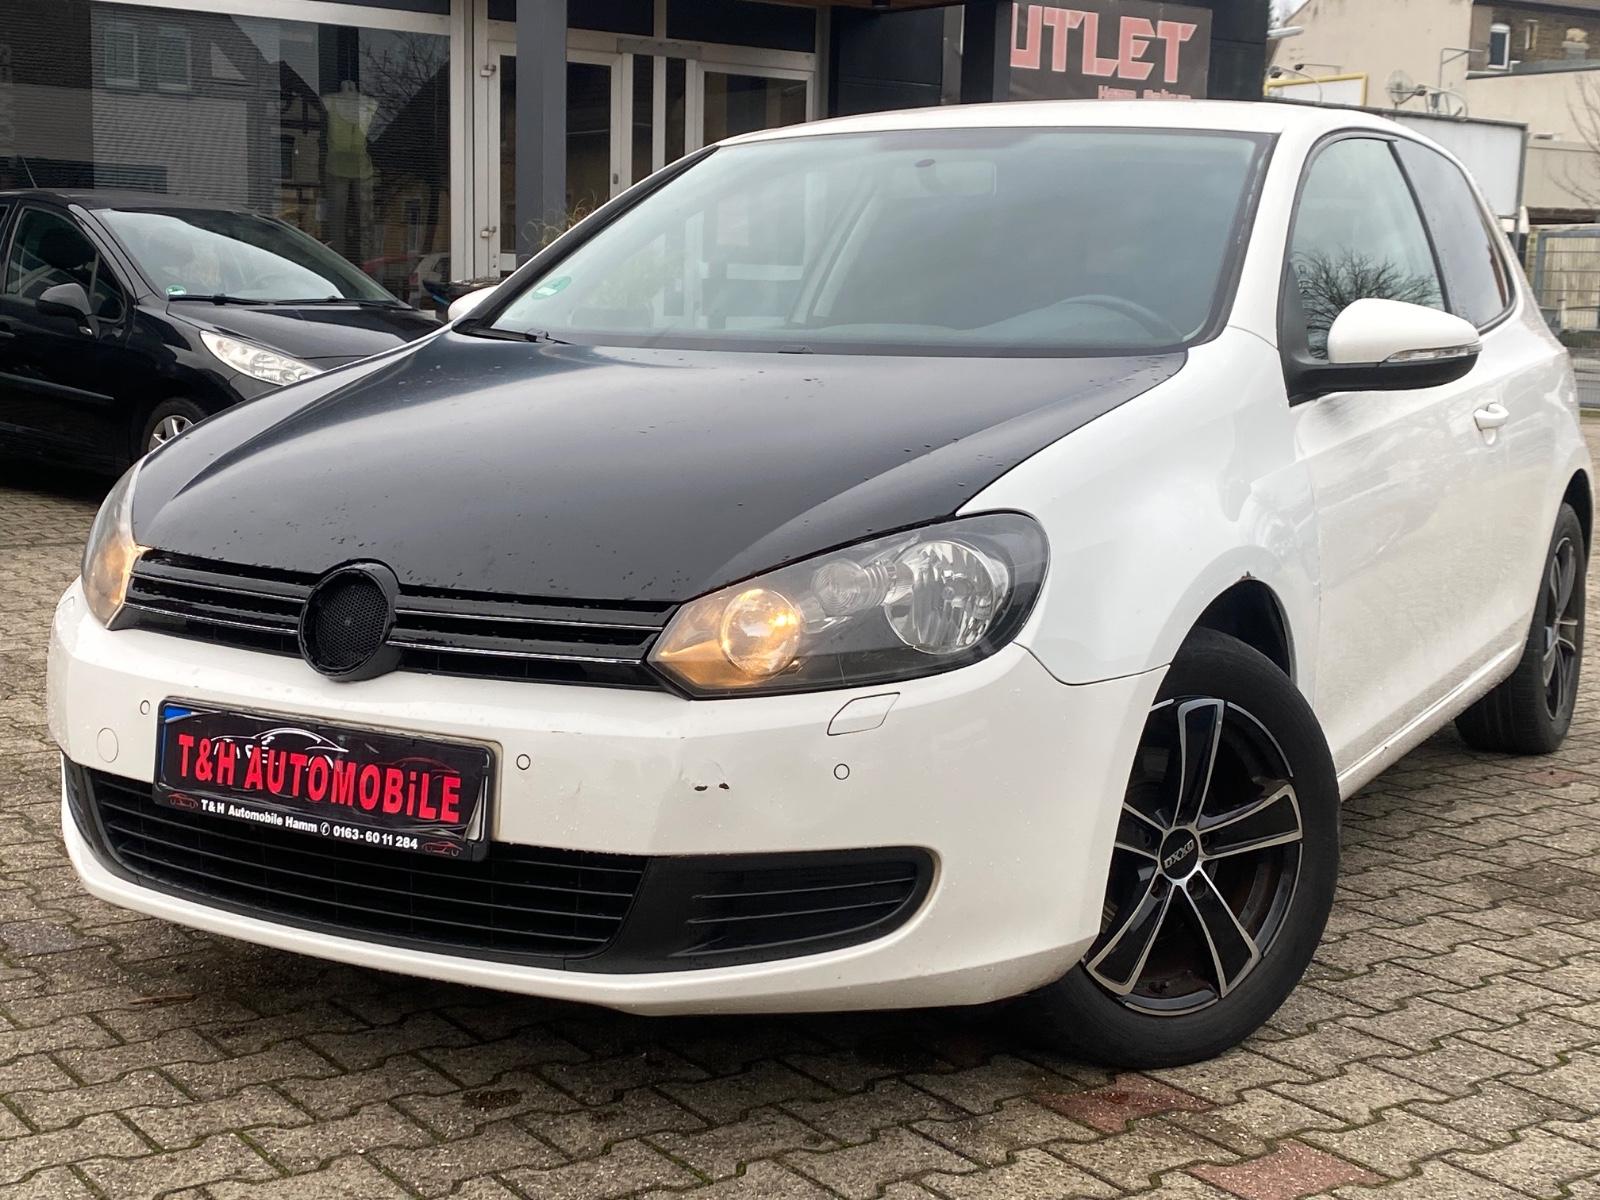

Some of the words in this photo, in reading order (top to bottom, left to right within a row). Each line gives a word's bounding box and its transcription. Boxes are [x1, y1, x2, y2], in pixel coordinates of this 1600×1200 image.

[178, 734, 236, 786] T&H
[201, 799, 225, 814] T&H
[228, 804, 283, 826] Automobile
[285, 815, 317, 833] Hamm
[395, 835, 418, 849] 284
